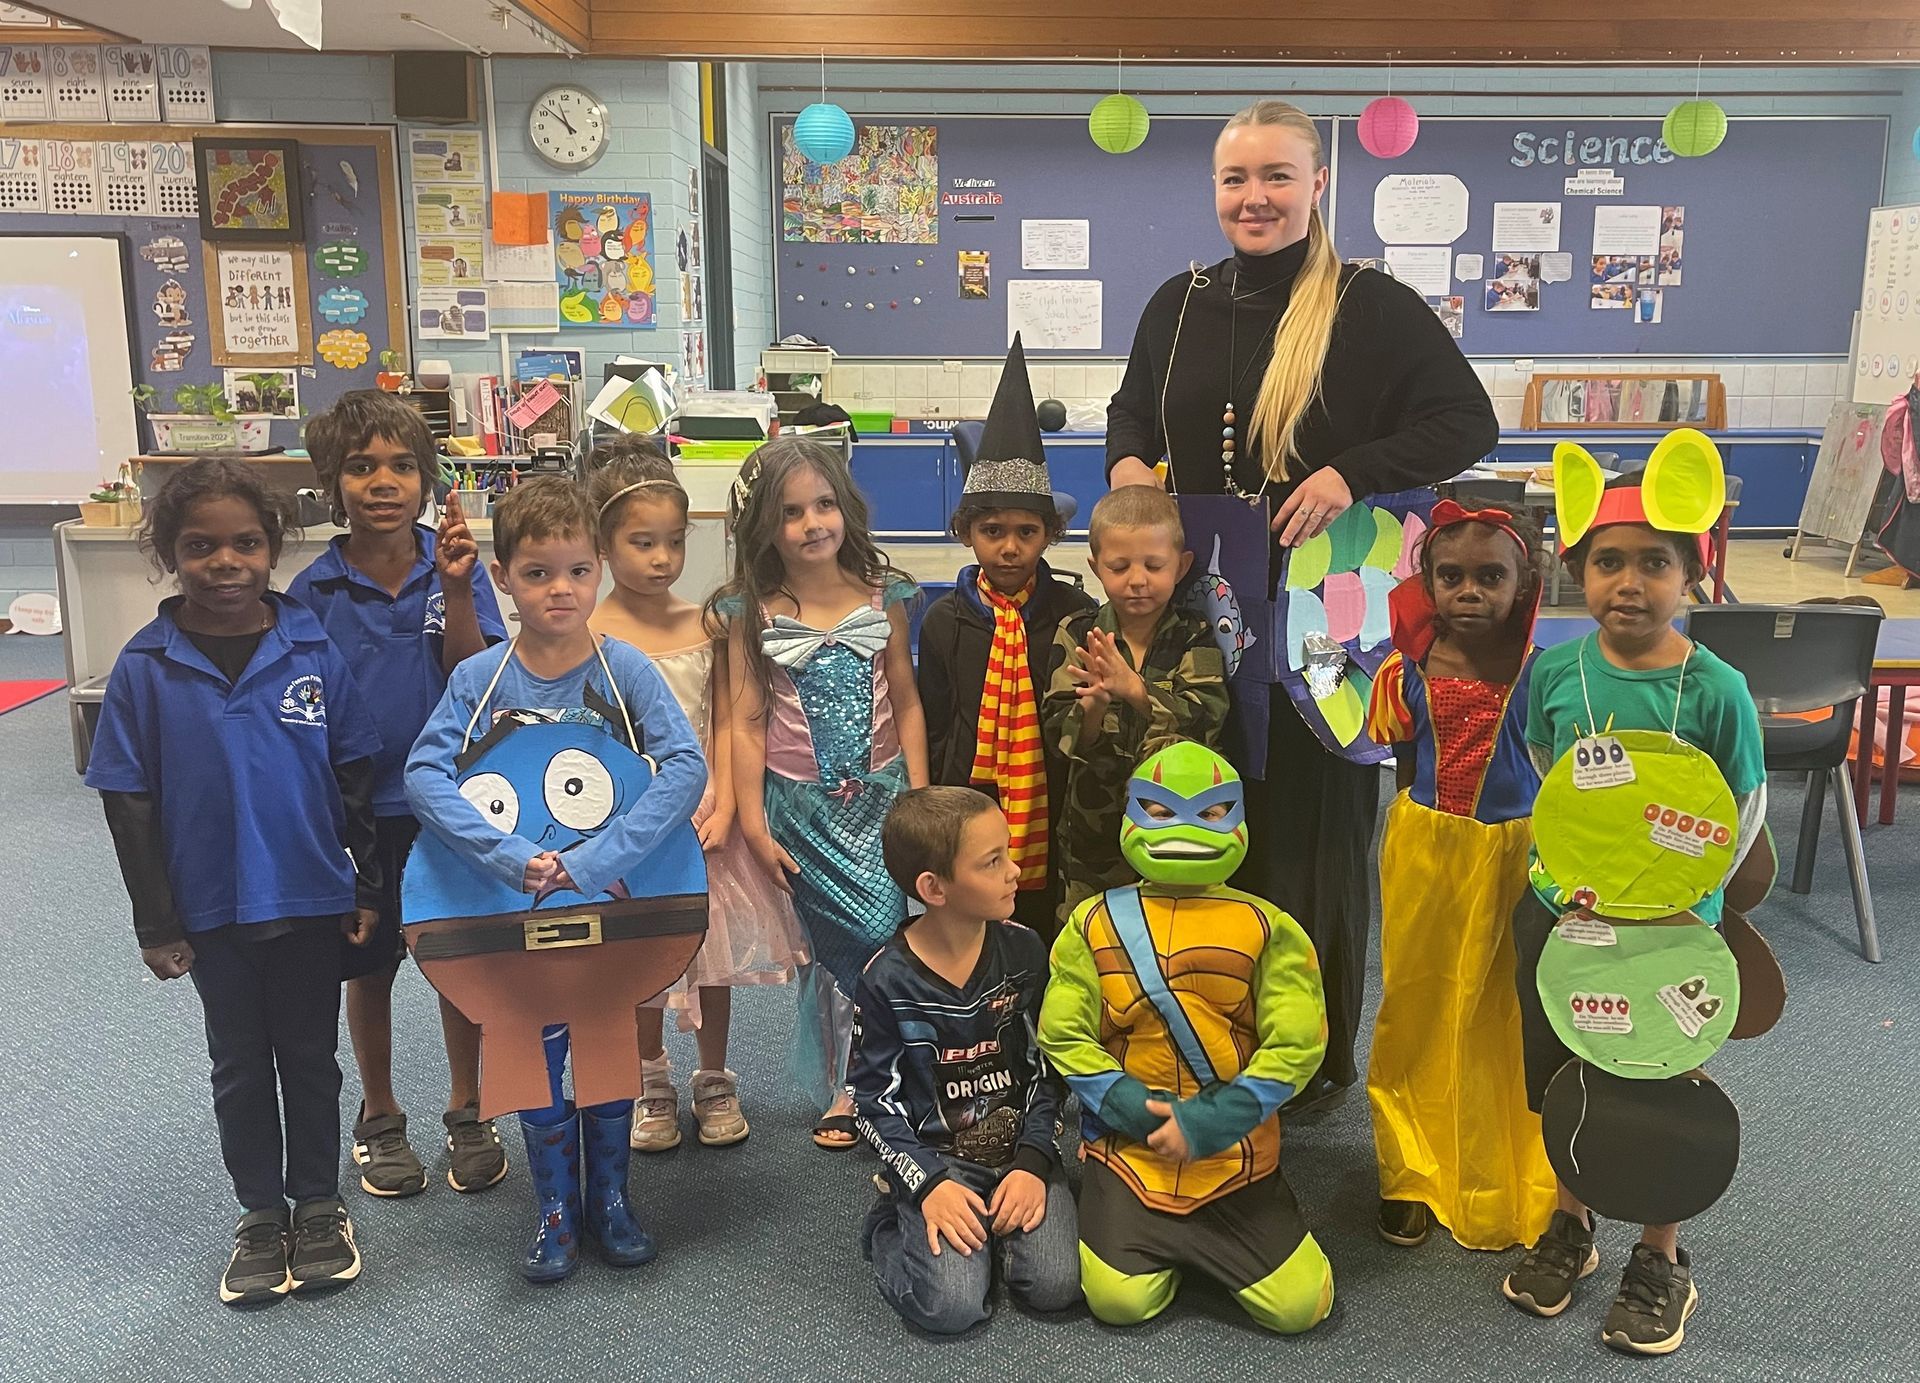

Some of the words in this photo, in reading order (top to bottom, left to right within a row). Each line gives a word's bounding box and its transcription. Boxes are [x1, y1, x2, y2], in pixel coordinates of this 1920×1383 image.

[52, 47, 68, 77] 8
[105, 47, 123, 77] 9
[160, 47, 191, 79] 10
[11, 78, 33, 86] seven
[66, 77, 86, 88] eight
[122, 78, 140, 87] nine
[179, 80, 193, 88] ten
[1510, 131, 1675, 167] Science
[48, 143, 75, 171] 18
[101, 143, 130, 173] 19
[153, 144, 185, 174] 20
[54, 173, 88, 184] eighteen
[109, 175, 143, 183] nineteen
[163, 176, 193, 185] twenty
[1566, 187, 1596, 195] Chemical
[1597, 187, 1622, 195] Science
[559, 193, 594, 205] Happy
[596, 193, 641, 206] Birthday
[941, 191, 1003, 205] Australia
[241, 257, 256, 267] may
[259, 255, 269, 264] all
[272, 255, 280, 264] be
[230, 313, 242, 323] but
[256, 313, 270, 323] this
[211, 433, 227, 441] 2022
[945, 1041, 998, 1061] PBR
[946, 1069, 1012, 1100] ORIGIN
[855, 1117, 891, 1160] SOUTH
